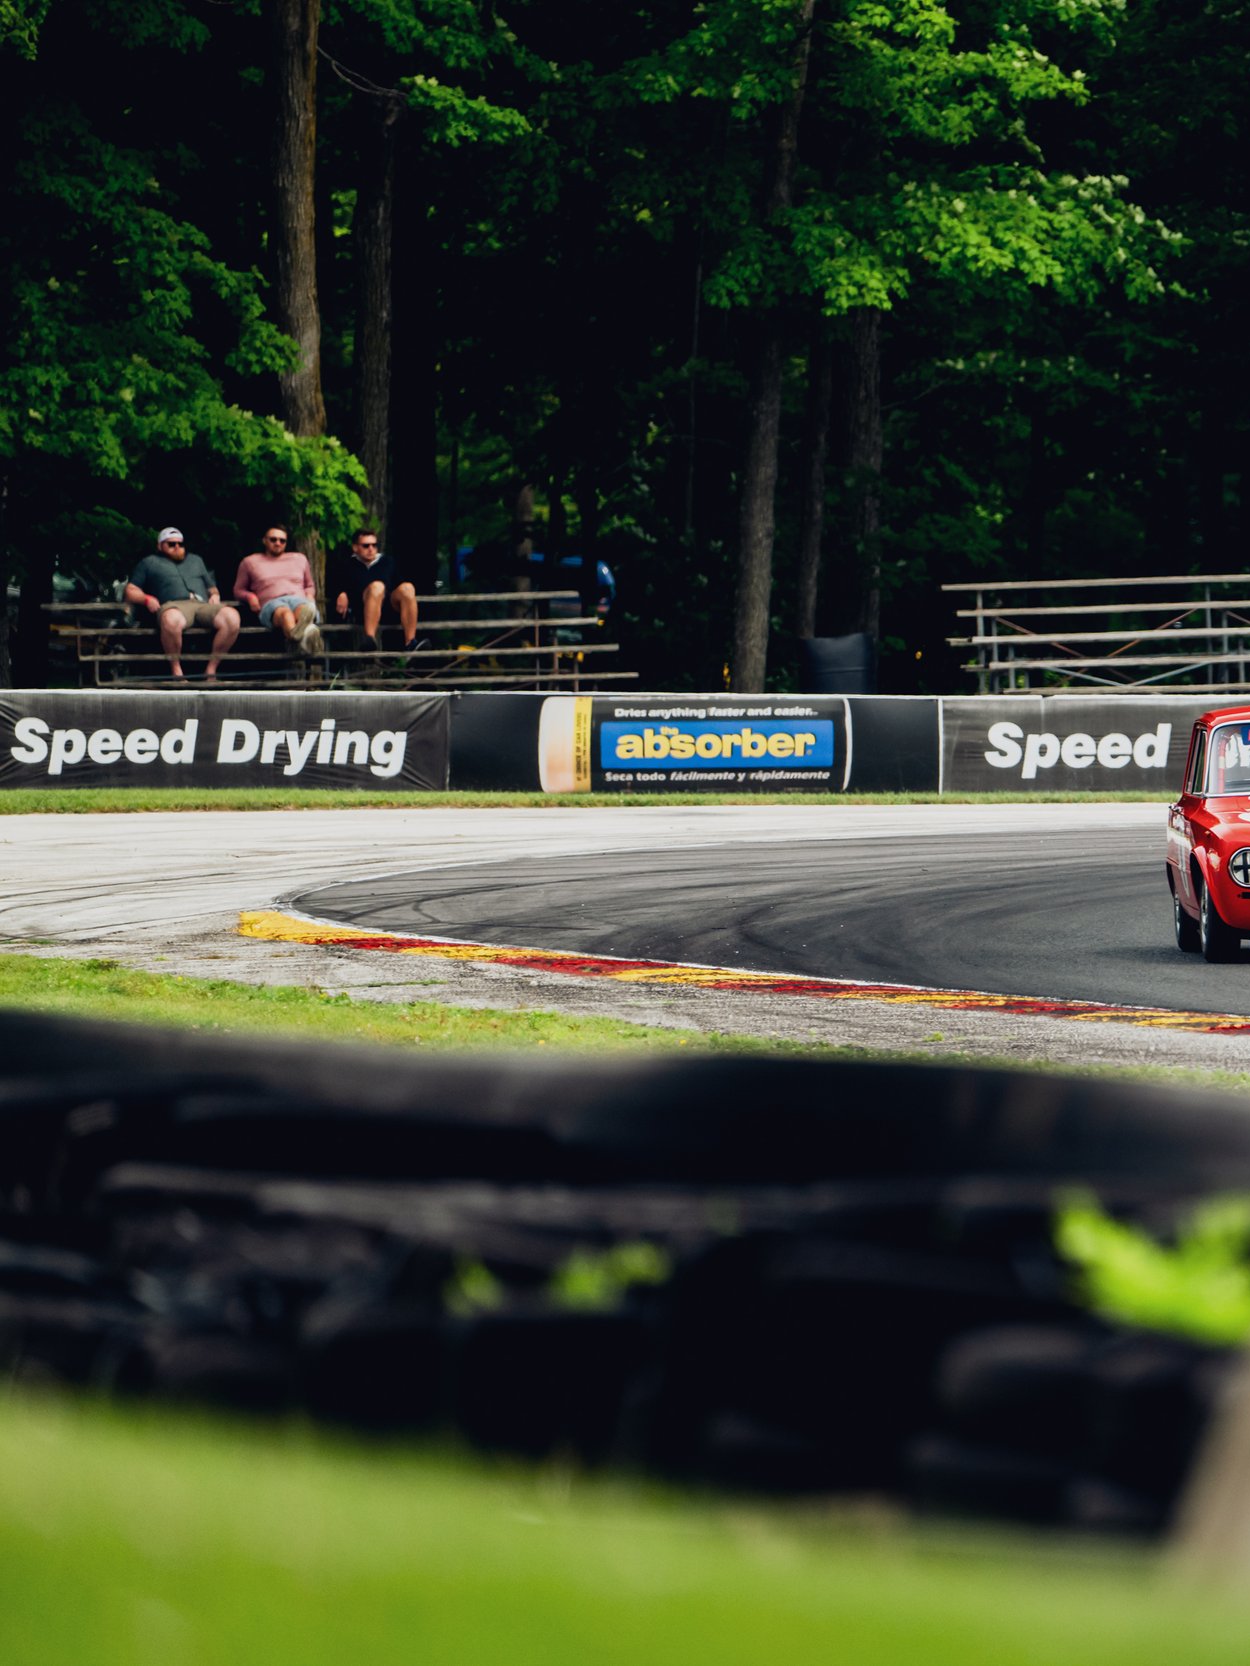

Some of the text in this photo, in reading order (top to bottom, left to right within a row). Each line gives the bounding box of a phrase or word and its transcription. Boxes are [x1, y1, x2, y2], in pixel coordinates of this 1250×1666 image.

[614, 708, 647, 718] Dries
[648, 707, 707, 719] anything
[708, 706, 746, 717] faster
[746, 706, 772, 717] and
[659, 725, 680, 736] the
[10, 716, 408, 778] Speed Drying
[614, 727, 816, 760] absorber
[983, 721, 1173, 780] Speed
[605, 770, 831, 782] Seca todo fácilmente y rápidamente
